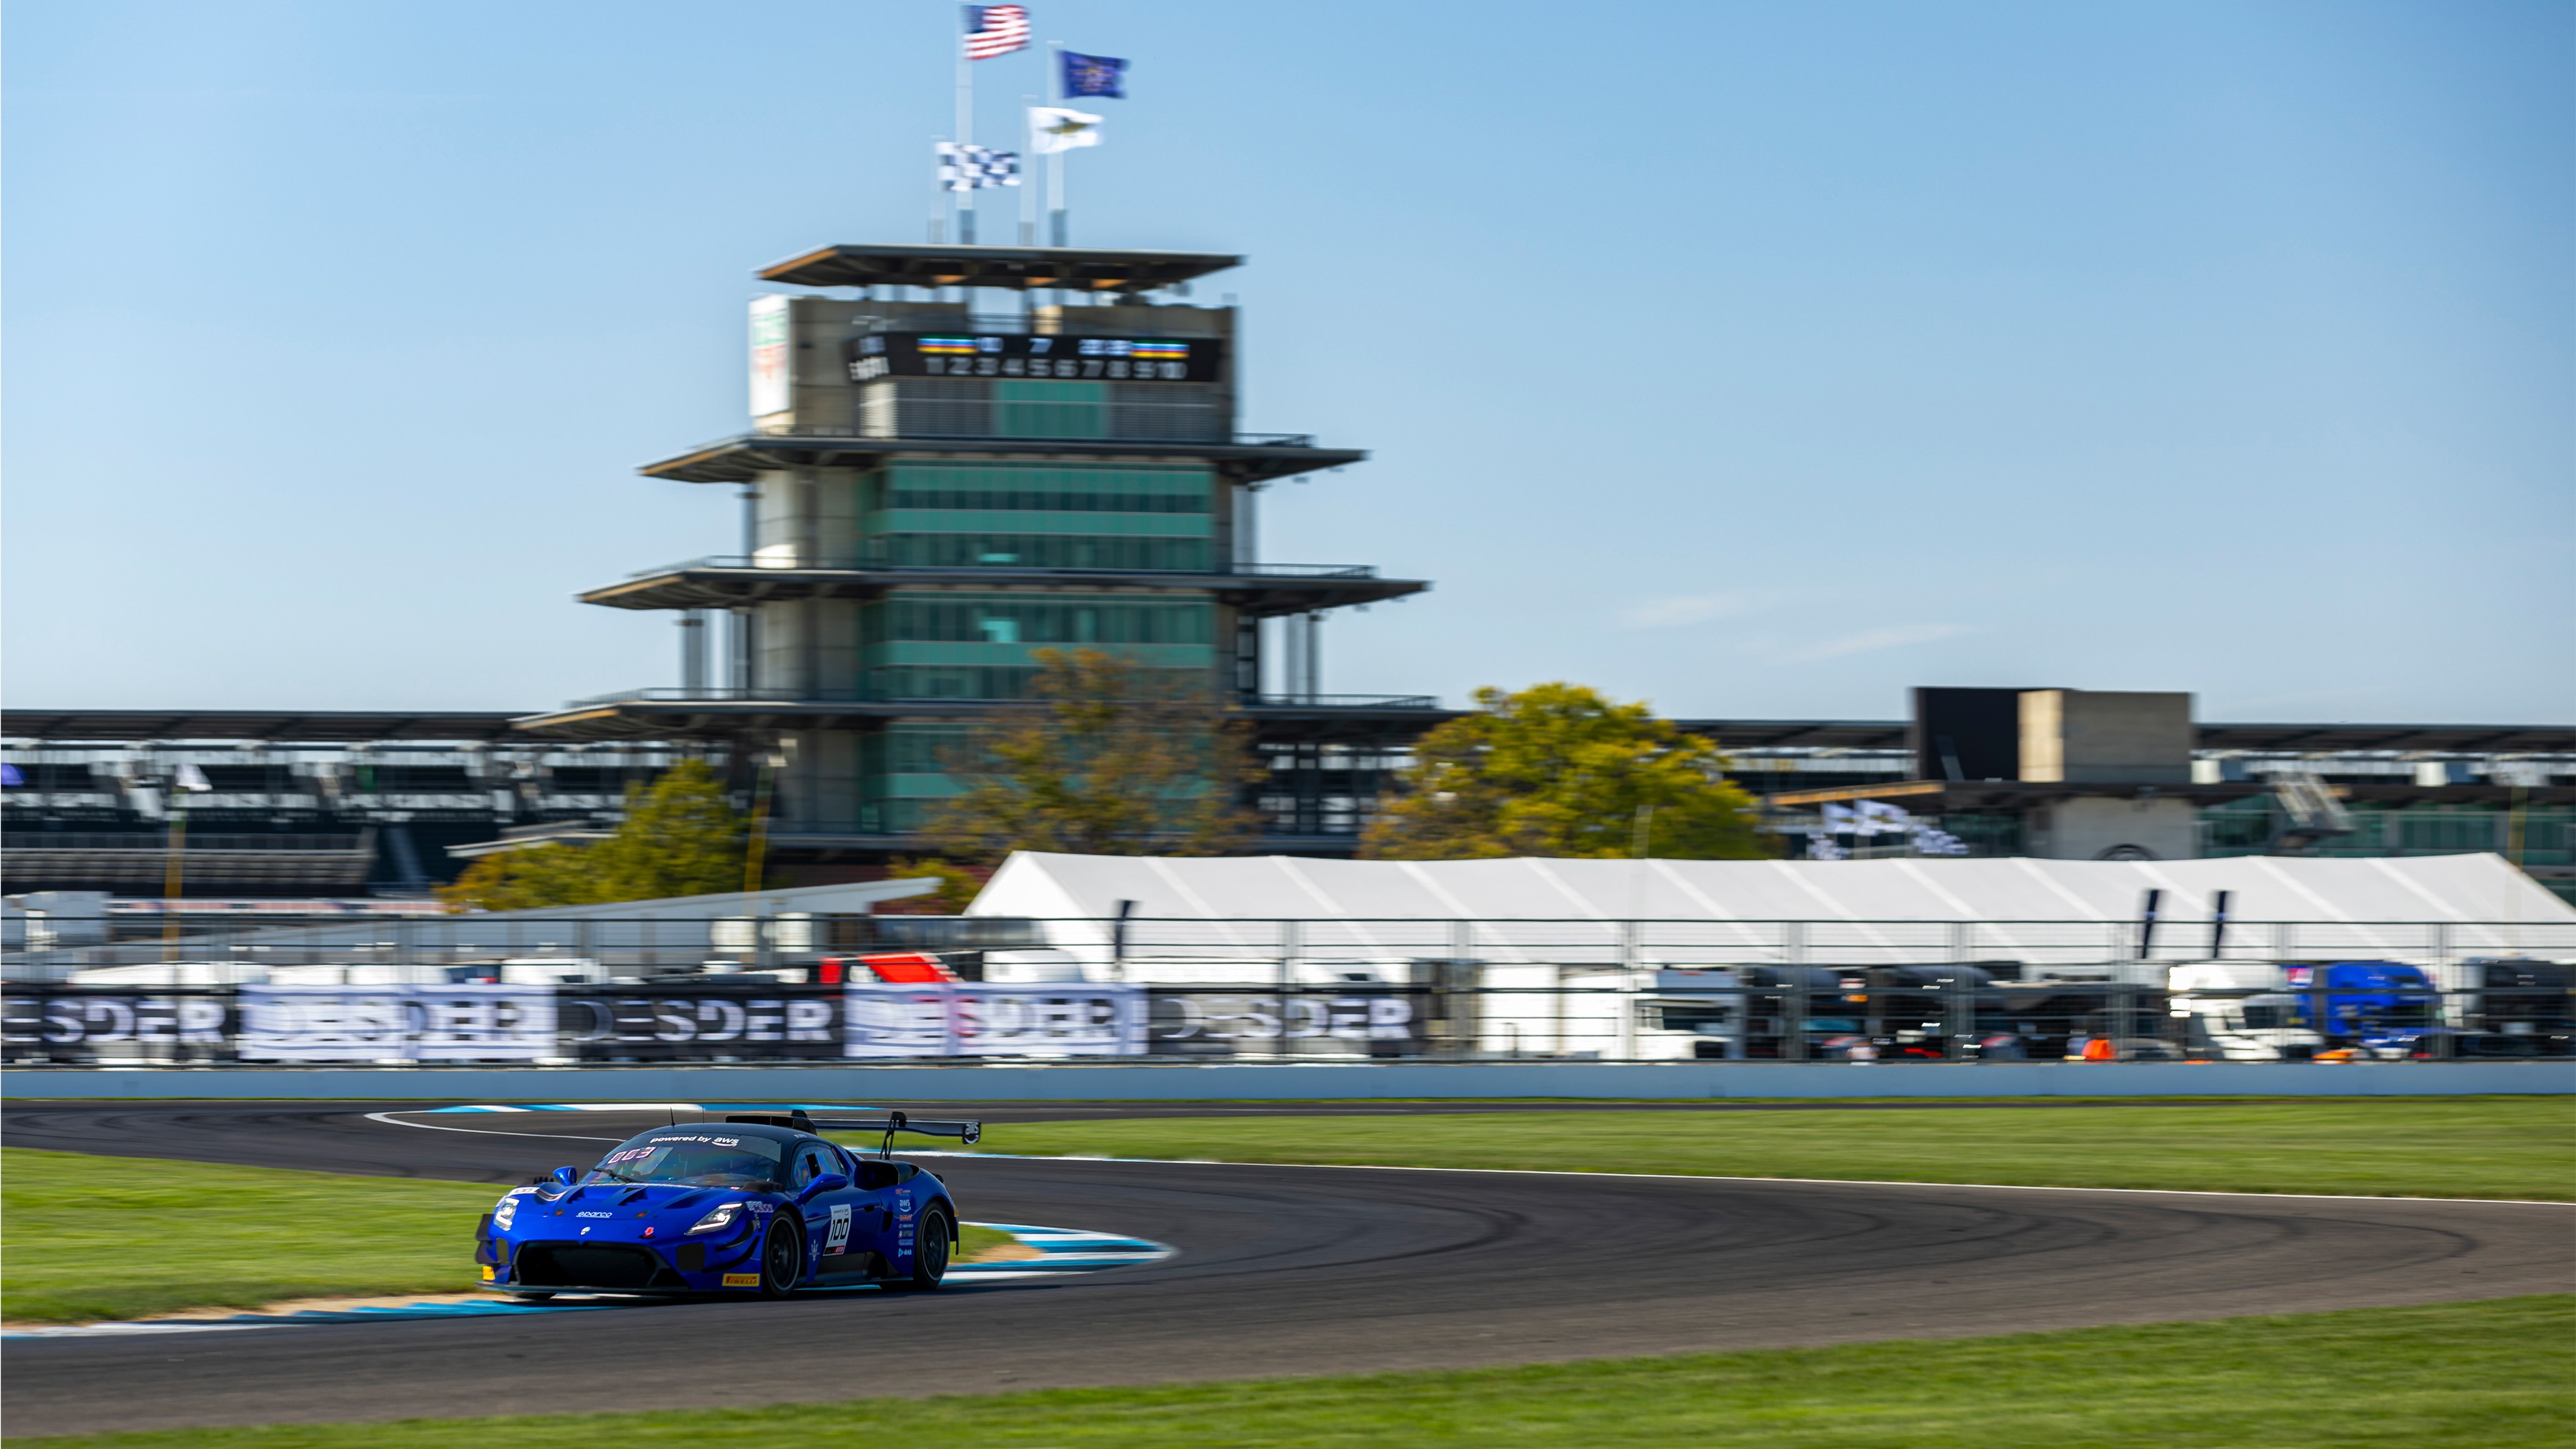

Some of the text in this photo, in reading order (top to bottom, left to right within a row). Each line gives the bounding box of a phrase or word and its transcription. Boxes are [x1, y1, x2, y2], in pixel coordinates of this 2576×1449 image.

[925, 358, 945, 374] 1
[948, 358, 973, 375] 2
[976, 358, 999, 375] 3
[1001, 358, 1025, 375] 4
[1028, 359, 1052, 376] 5
[1054, 359, 1079, 377] 6
[1081, 360, 1104, 377] 7
[1107, 360, 1131, 378] 8
[1133, 361, 1156, 379] 9
[570, 1000, 834, 1041] DESDER
[1161, 999, 1413, 1039] DESDER
[713, 1137, 739, 1146] aws
[899, 1199, 911, 1208] aws
[829, 1218, 849, 1241] 100
